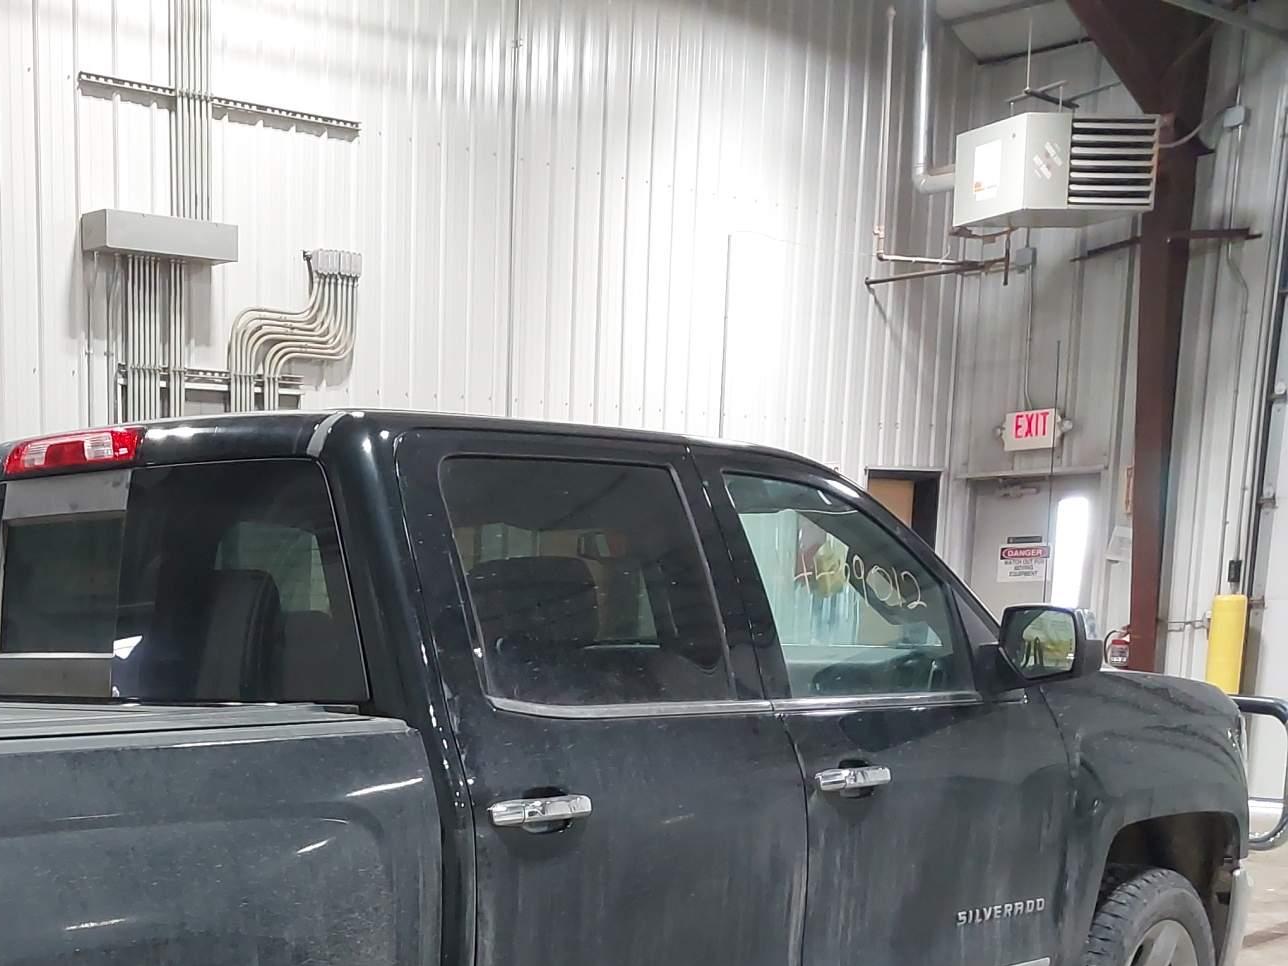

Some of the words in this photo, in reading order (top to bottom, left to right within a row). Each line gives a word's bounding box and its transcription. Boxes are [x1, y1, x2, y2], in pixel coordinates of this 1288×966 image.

[1015, 412, 1050, 438] EXIT
[1007, 549, 1042, 557] DANGER
[956, 898, 1045, 926] SILVERADO
